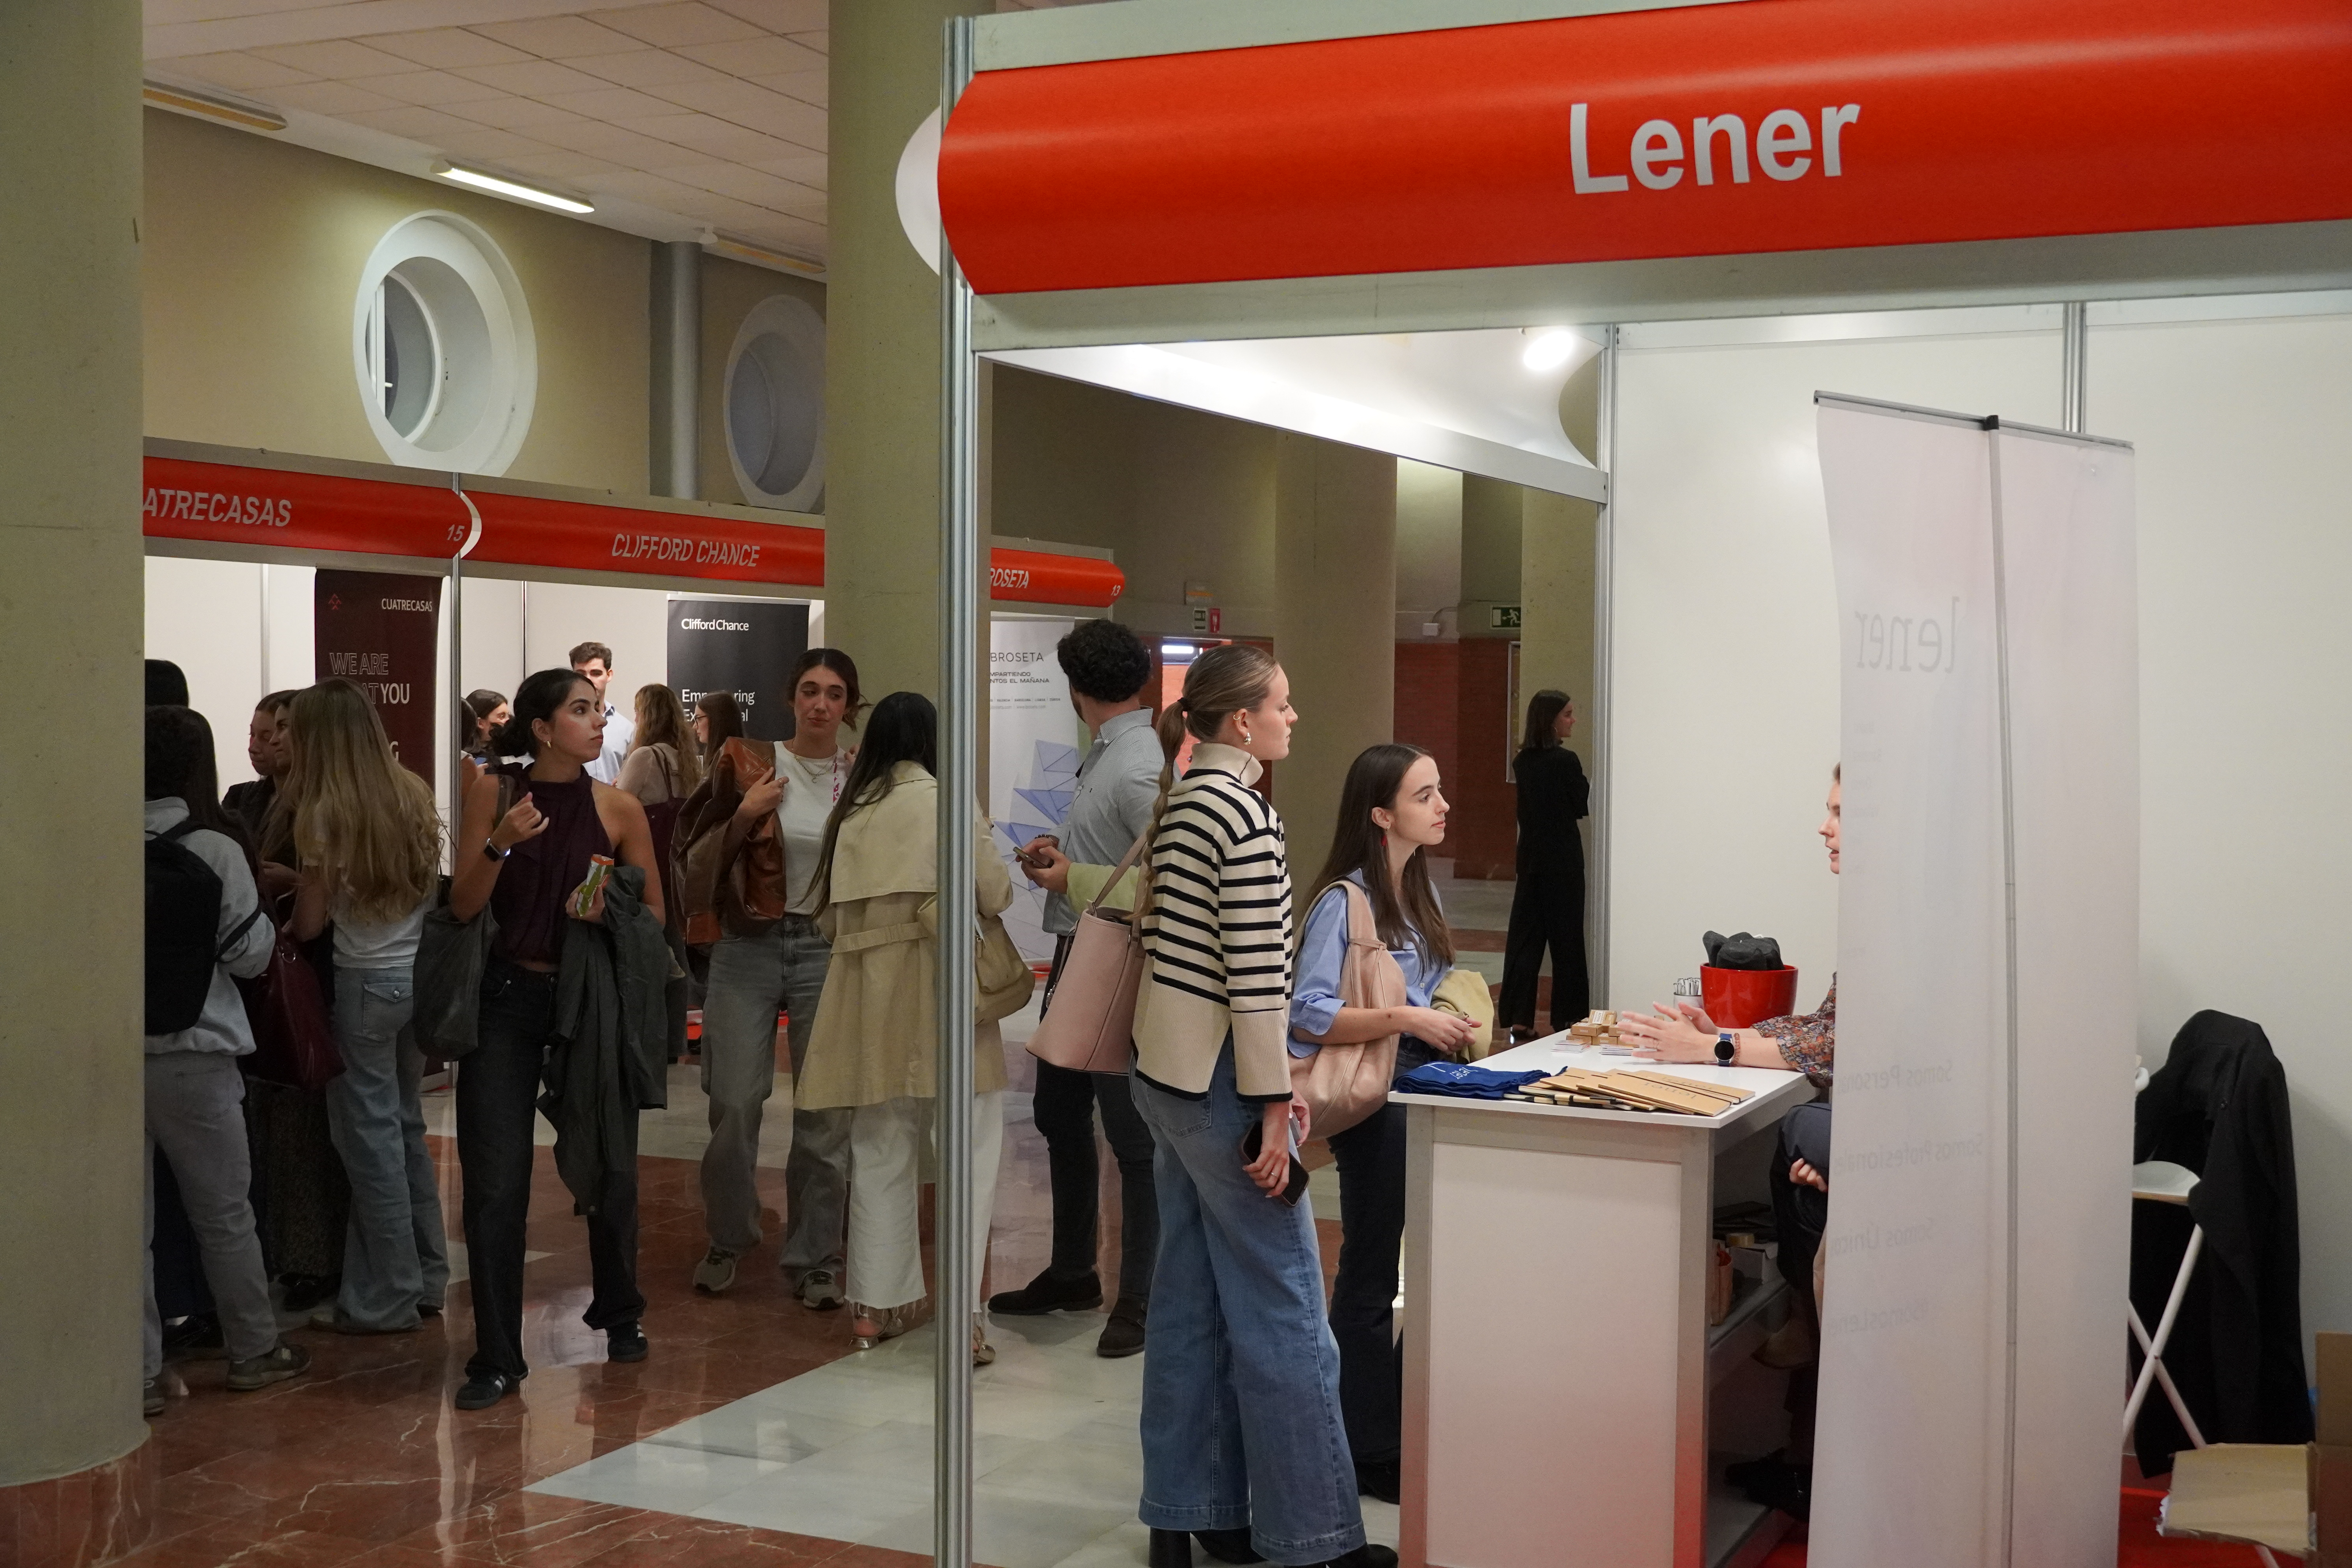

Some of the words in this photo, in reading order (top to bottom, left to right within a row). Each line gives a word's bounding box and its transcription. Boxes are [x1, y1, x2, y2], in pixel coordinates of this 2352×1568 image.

[1570, 103, 1861, 194] Lener
[143, 488, 292, 527] ATRECASAS
[447, 524, 465, 542] 15
[612, 534, 693, 561] CLIFFORD
[696, 540, 760, 567] CHANCE
[1111, 584, 1121, 596] 13
[381, 598, 432, 612] CUATRECASAS
[681, 619, 715, 630] Clifford
[716, 619, 749, 631] Chance
[330, 653, 357, 674] WE
[359, 653, 389, 675] ARE
[991, 652, 1044, 662] BROSETA
[380, 683, 410, 704] YOU
[682, 689, 755, 705] Emring
